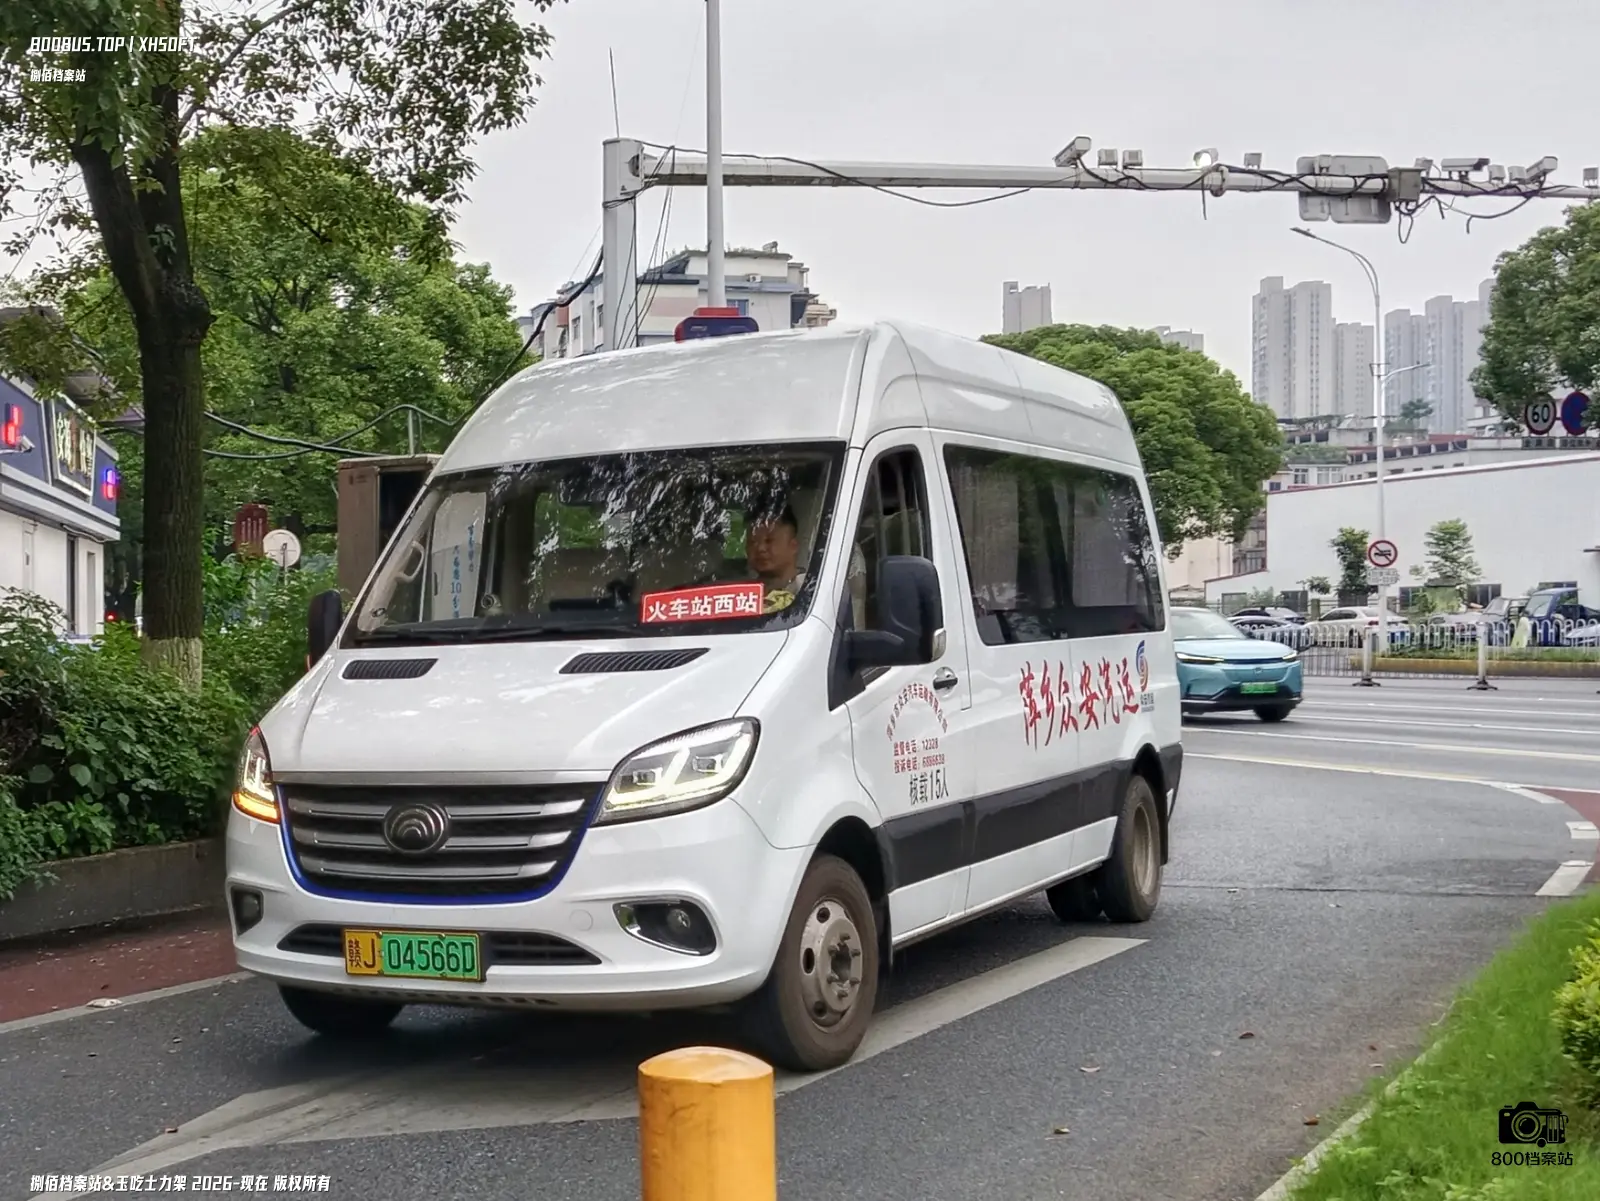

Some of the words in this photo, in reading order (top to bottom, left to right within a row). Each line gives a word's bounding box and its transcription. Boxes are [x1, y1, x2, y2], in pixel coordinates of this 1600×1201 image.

[1532, 403, 1550, 423] 60
[644, 591, 758, 622] 火车站西站
[1019, 656, 1139, 752] 萍乡众安汽运
[909, 767, 949, 806] 核载15人
